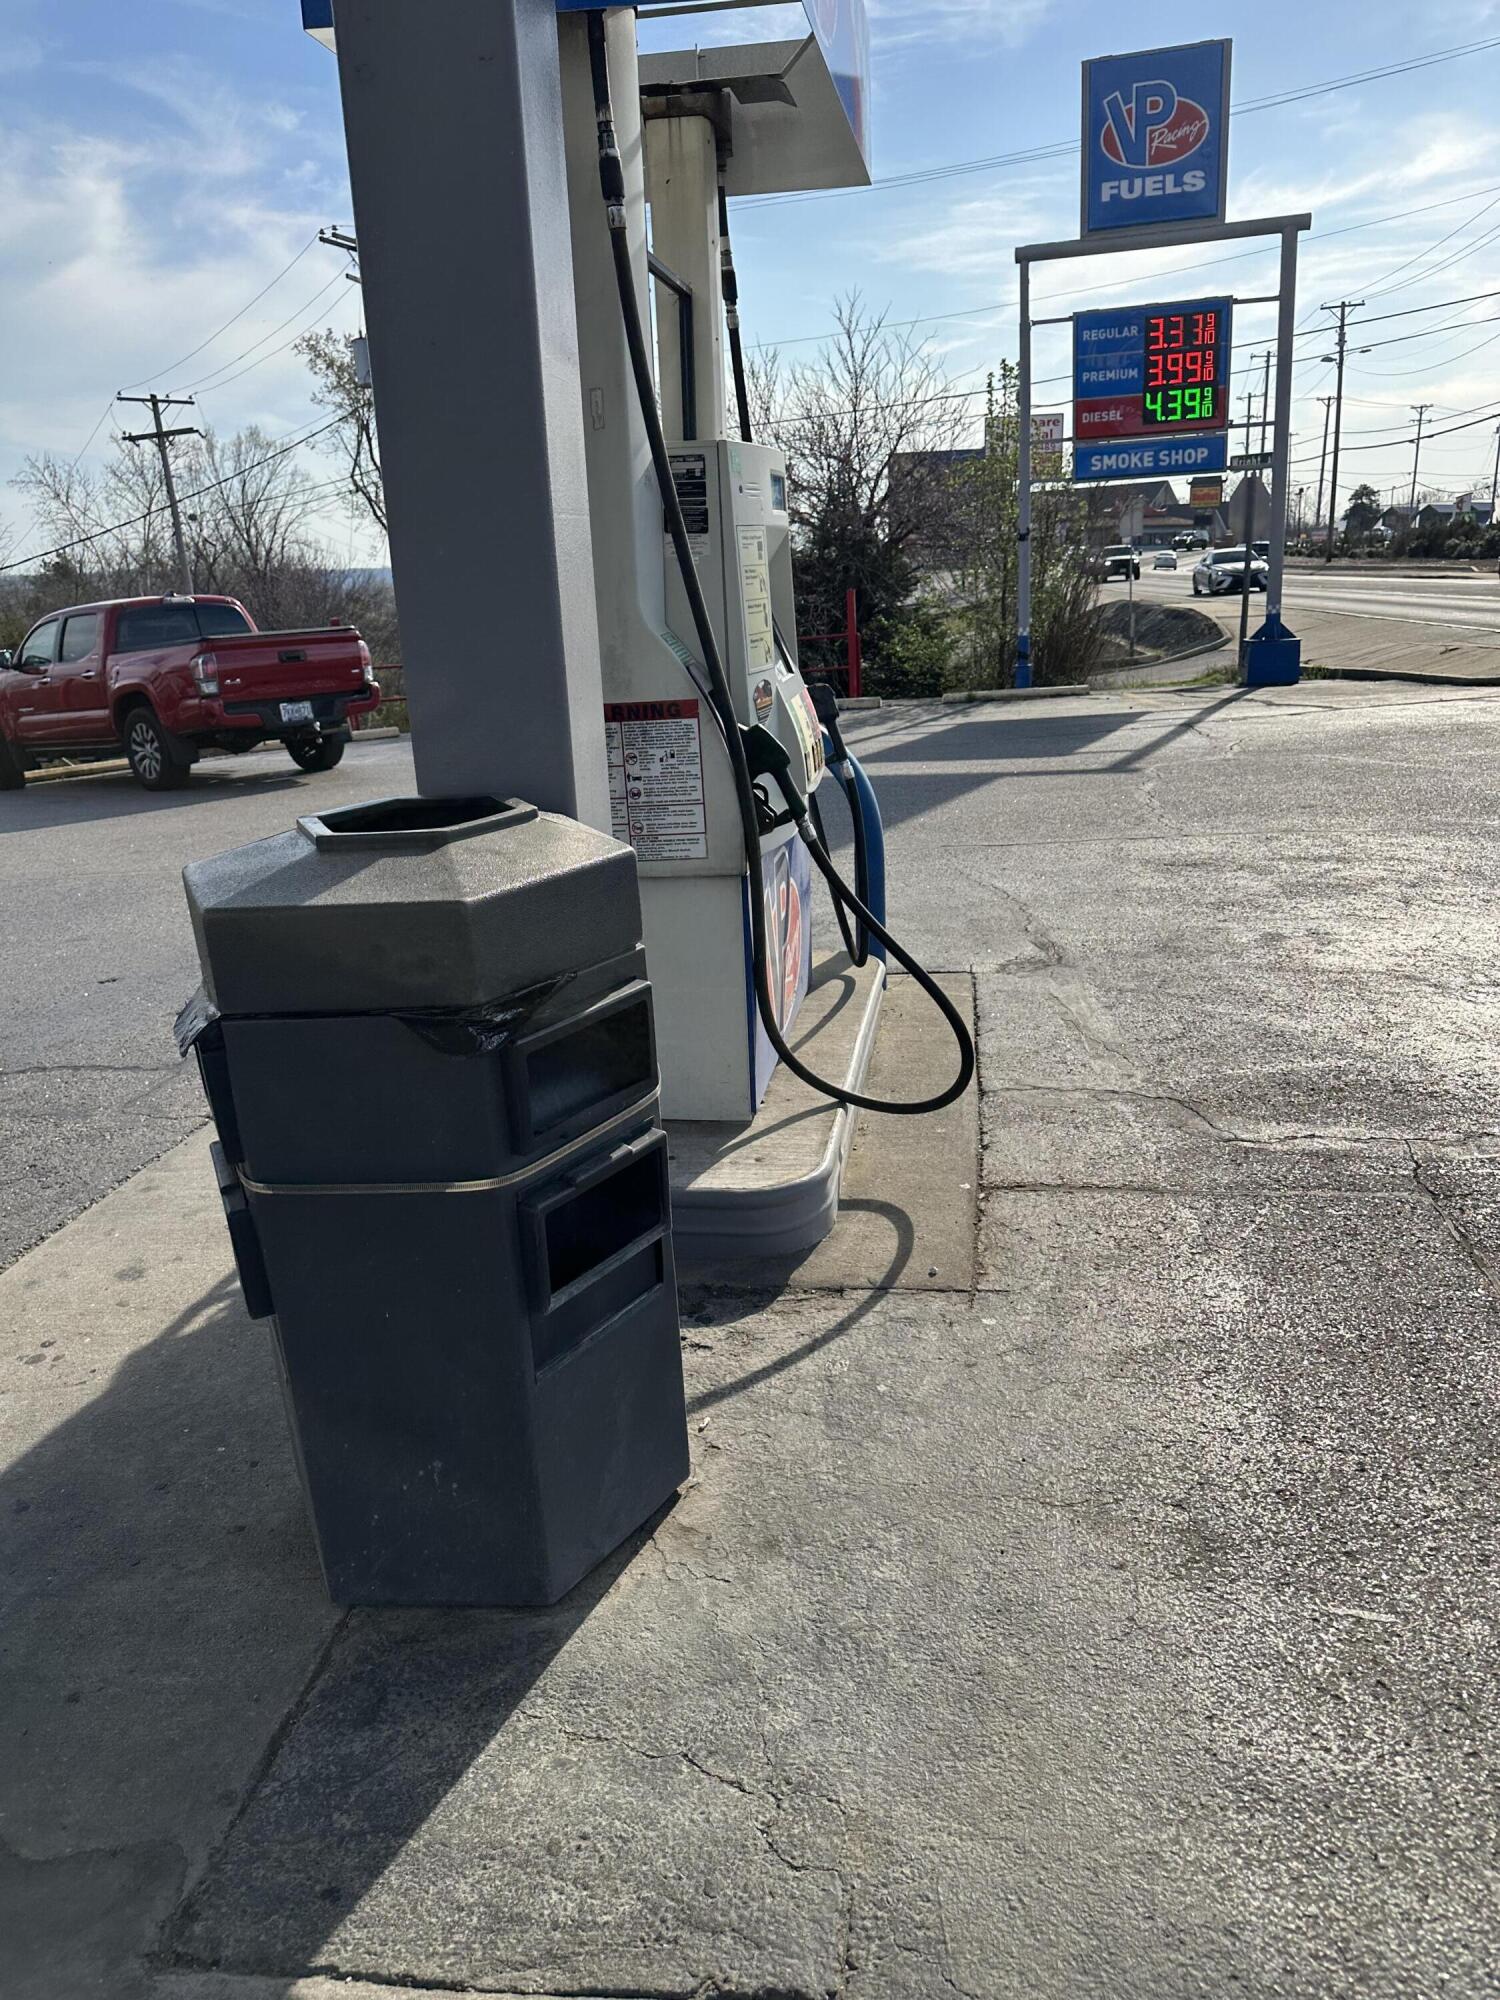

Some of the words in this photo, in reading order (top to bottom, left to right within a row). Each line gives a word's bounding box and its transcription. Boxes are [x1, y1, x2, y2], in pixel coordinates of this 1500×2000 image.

[1103, 79, 1177, 166] VP
[1150, 118, 1206, 155] Racing
[1101, 170, 1206, 202] FUELS
[1082, 325, 1139, 341] REGULAR
[1082, 368, 1138, 383] PREMIUM
[1148, 351, 1202, 387] 3.99
[1082, 410, 1124, 424] DIESEL
[1145, 387, 1201, 421] 4.39
[1090, 451, 1154, 471] SMOKE
[1159, 447, 1209, 466] SHOP
[610, 702, 681, 721] RNING
